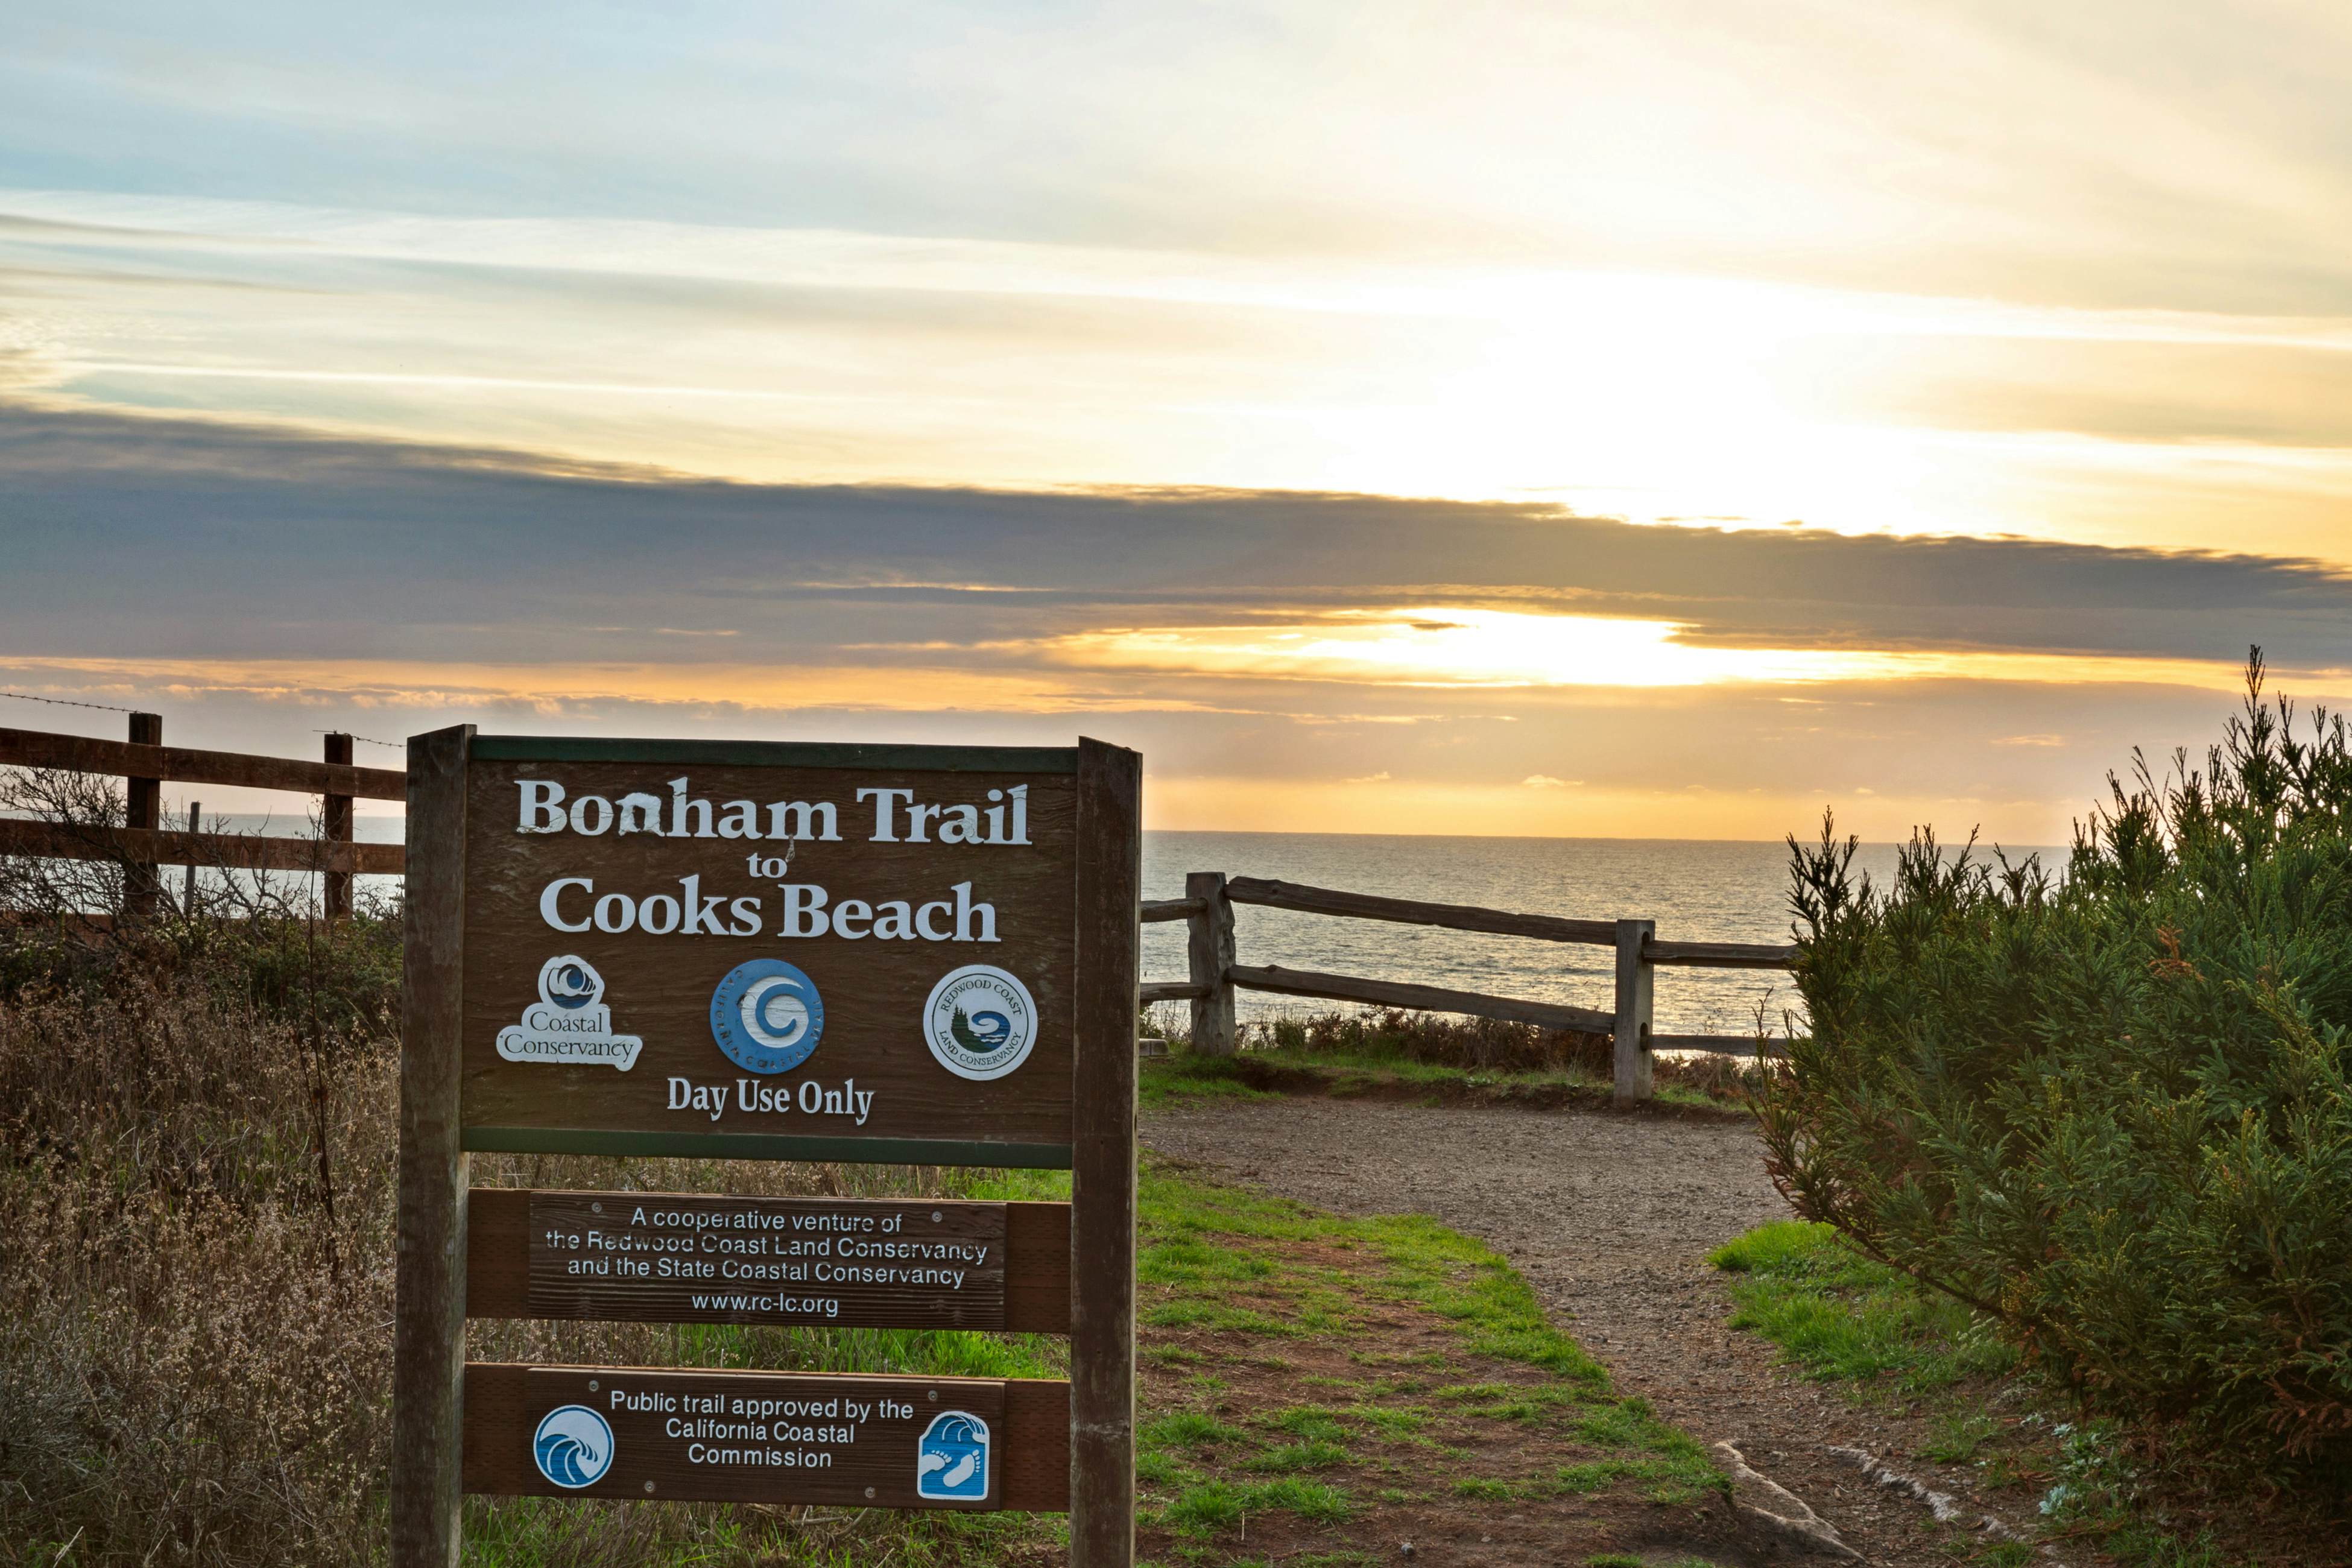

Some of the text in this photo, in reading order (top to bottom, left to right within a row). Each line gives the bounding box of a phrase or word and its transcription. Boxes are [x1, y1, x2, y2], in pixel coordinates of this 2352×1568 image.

[514, 776, 1032, 845] Bonham Trail
[747, 852, 788, 879] to
[540, 874, 1001, 943] Cooks Beach
[941, 979, 1022, 1016] REDWOOD COAST
[530, 1011, 602, 1032] Coastal
[504, 1034, 634, 1063] Conservancy
[940, 1030, 1022, 1066] LAND CONSERVANCY
[667, 1078, 874, 1127] Day Use Only
[631, 1207, 902, 1233] A cooperative venture of
[546, 1231, 987, 1265] the Redwood Coast Land Conservancy
[567, 1256, 965, 1289] and the State Coastal Conservancy
[692, 1292, 839, 1318] www.rc-lc.org
[611, 1391, 914, 1422] Public trail approved by the
[665, 1418, 855, 1443] California Coastal
[688, 1444, 832, 1467] Commission
